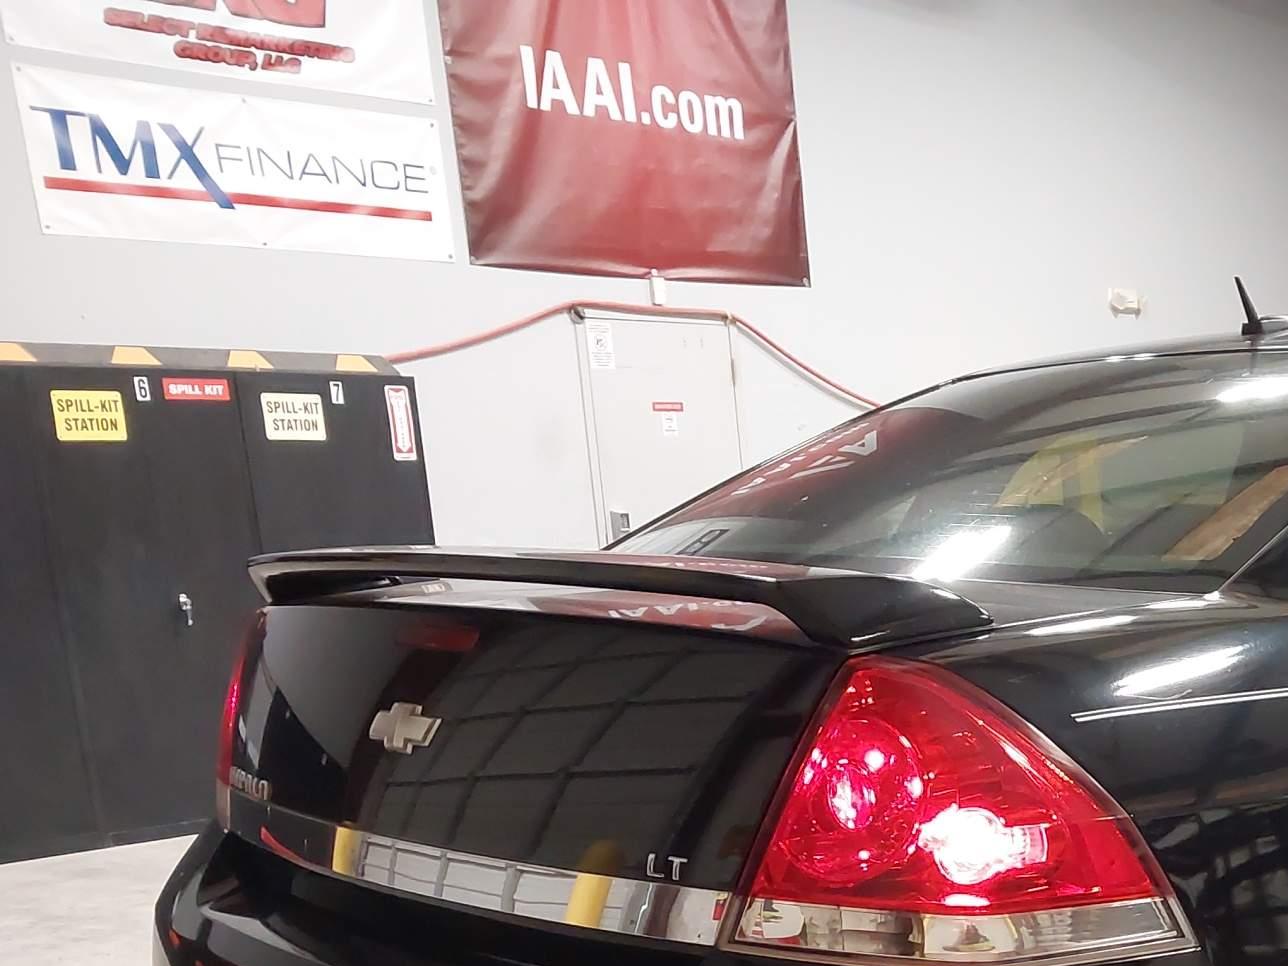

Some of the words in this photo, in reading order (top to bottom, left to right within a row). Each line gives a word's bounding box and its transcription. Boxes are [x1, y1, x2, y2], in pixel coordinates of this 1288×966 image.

[519, 45, 745, 140] IAAI.com
[29, 105, 235, 210] TMX
[215, 143, 430, 194] FINANCE
[138, 378, 148, 399] 6
[168, 383, 203, 396] SPILL
[204, 384, 224, 396] KIT
[332, 383, 341, 402] 7
[57, 399, 119, 412] SPILL-KIT
[266, 401, 319, 415] SPILL-KIT
[65, 418, 118, 431] STATION
[273, 418, 318, 432] STATION
[646, 853, 688, 880] LT
